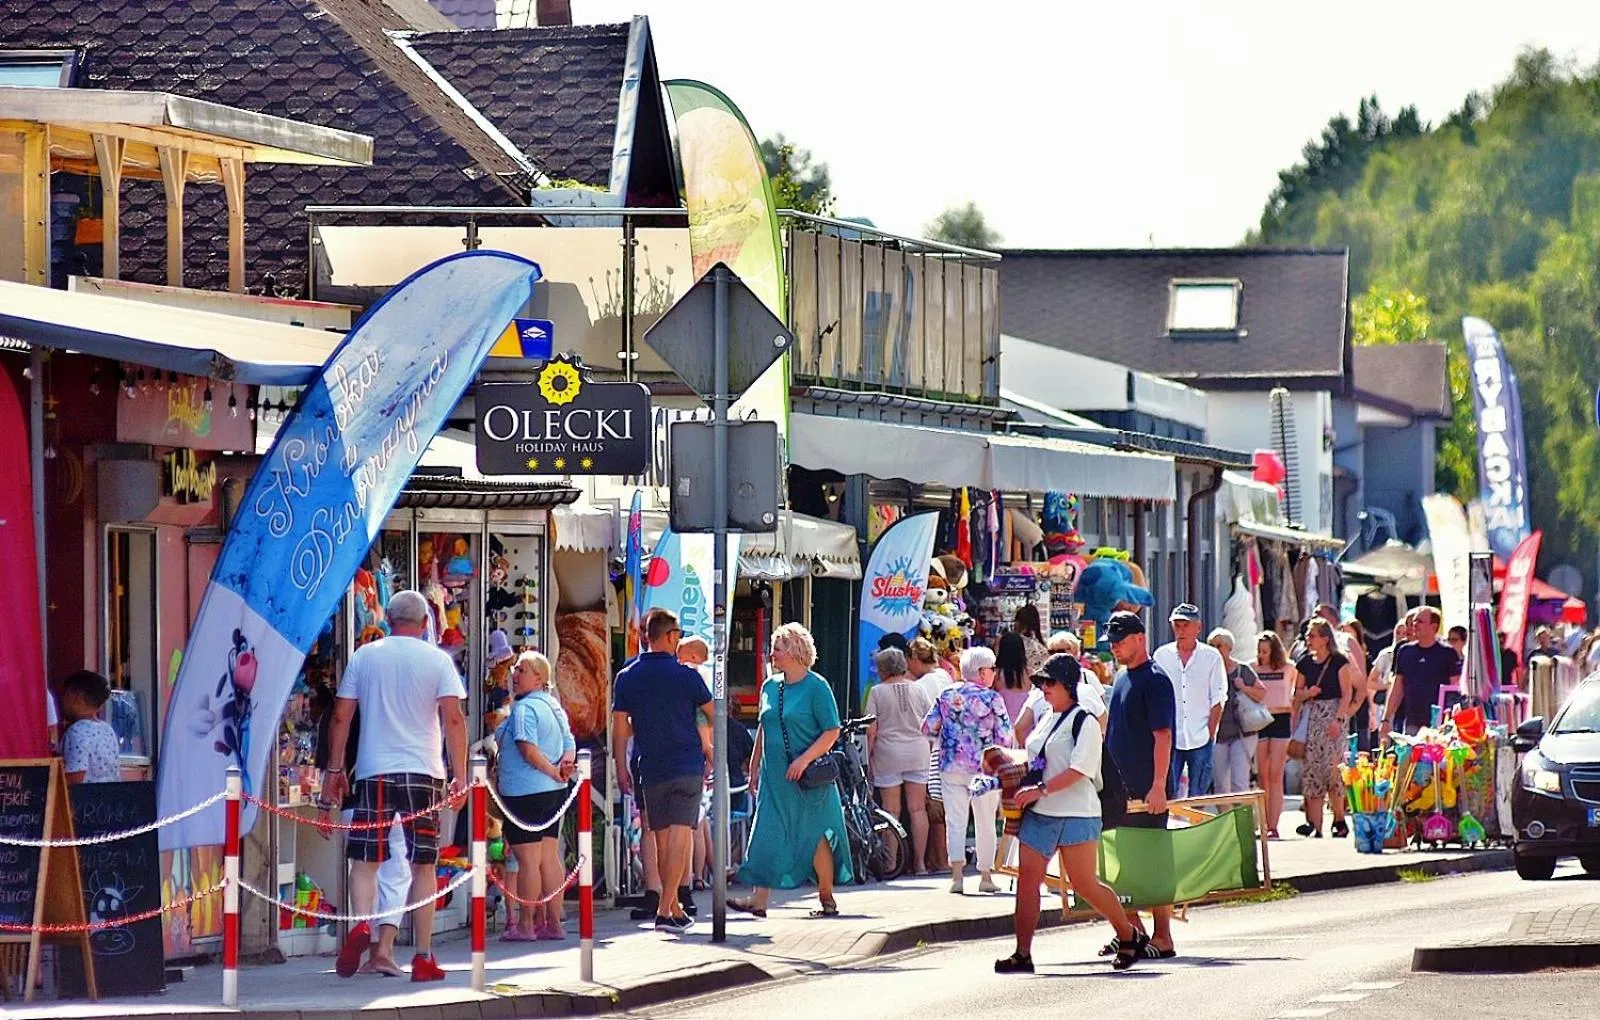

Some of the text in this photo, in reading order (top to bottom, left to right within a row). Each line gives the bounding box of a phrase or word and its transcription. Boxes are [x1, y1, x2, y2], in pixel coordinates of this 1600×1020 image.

[483, 405, 633, 441] OLECKI
[255, 350, 380, 538] Krówka
[339, 444, 358, 478] z
[515, 442, 604, 453] HOLIDAY HAUS
[871, 574, 922, 604] Slushy
